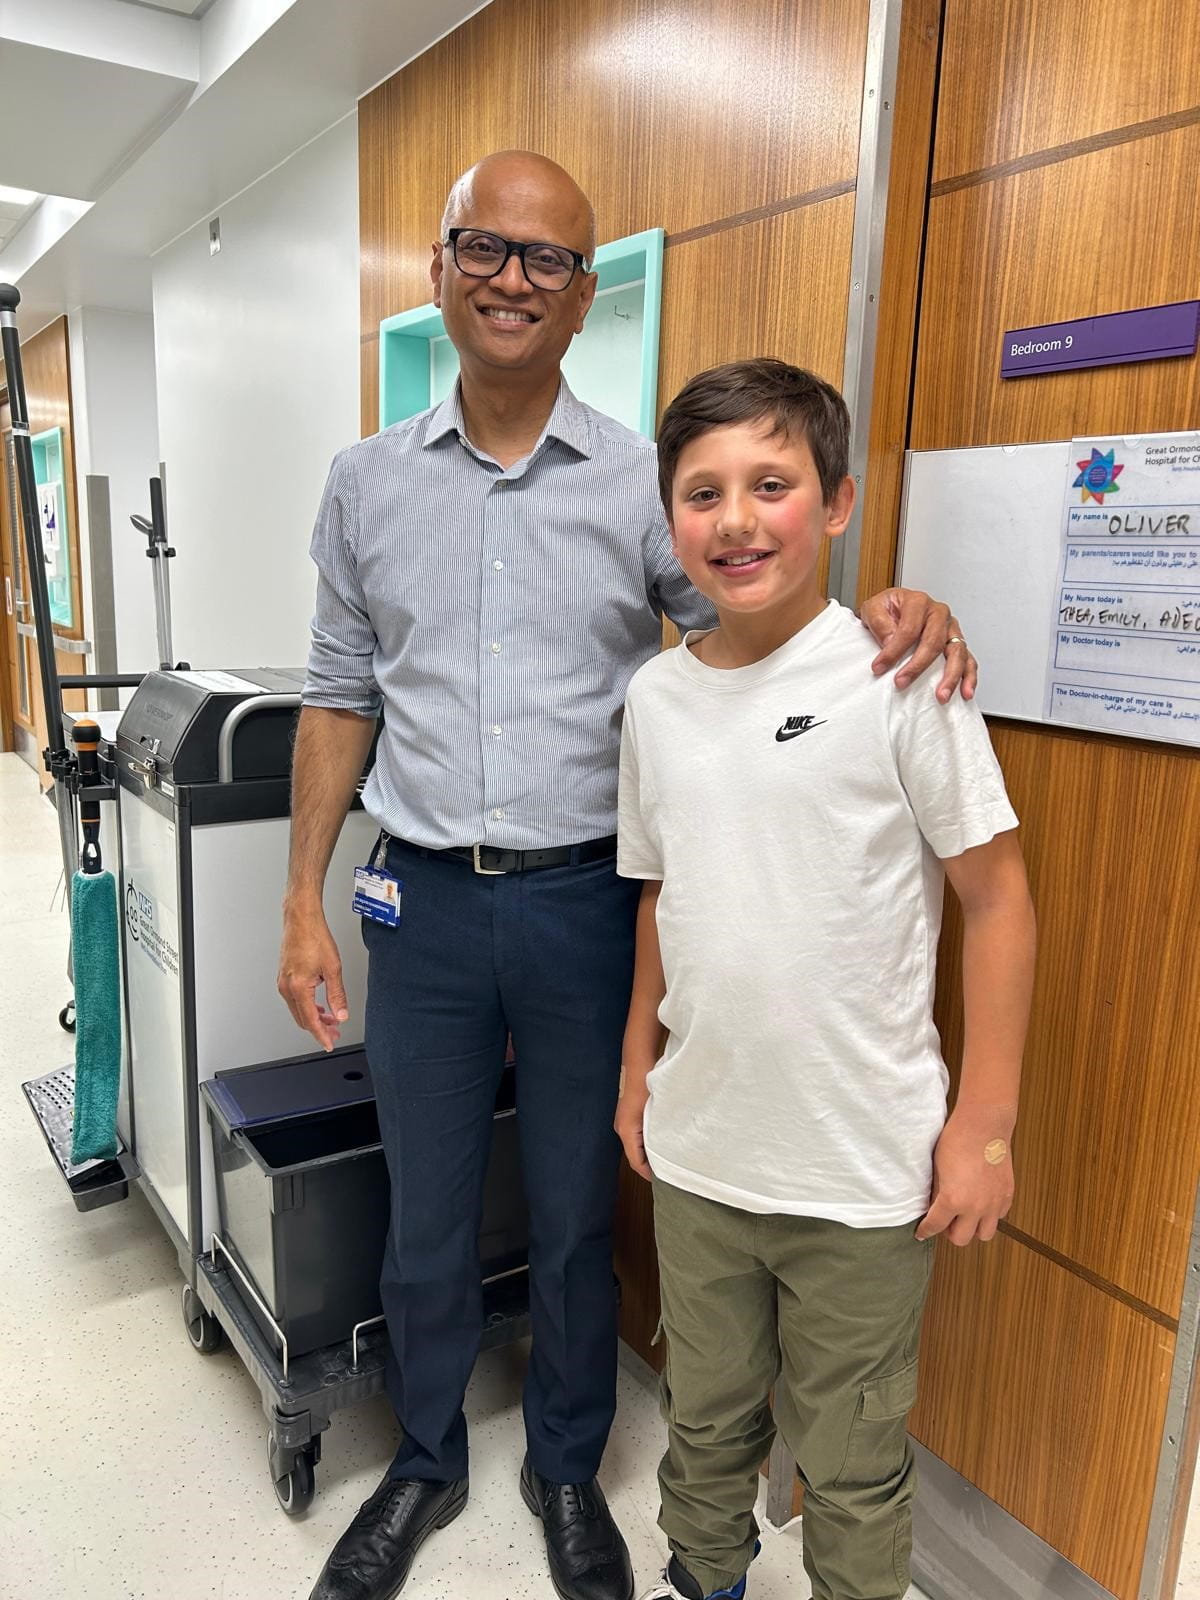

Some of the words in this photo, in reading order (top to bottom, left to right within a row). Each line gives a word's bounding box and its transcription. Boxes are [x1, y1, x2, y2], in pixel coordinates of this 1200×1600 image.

[1011, 340, 1061, 356] Bedroom
[1065, 335, 1073, 349] 9
[1145, 447, 1167, 455] Great
[1145, 457, 1176, 466] Hospital
[1178, 456, 1190, 464] for
[1071, 513, 1081, 521] My
[1109, 514, 1190, 535] OLIVER
[1070, 549, 1079, 557] My
[1081, 550, 1131, 558] parents/carers
[1157, 550, 1169, 558] like
[1172, 552, 1187, 560] you
[1064, 594, 1073, 602] My
[1076, 594, 1095, 602] Nurse
[1097, 596, 1115, 604] today
[1060, 635, 1070, 643] My
[1073, 636, 1095, 645] Doctor
[1095, 640, 1113, 648] today
[1069, 690, 1124, 703] Doctor-in-charge
[783, 715, 815, 730] NIKE
[139, 893, 152, 919] NHS
